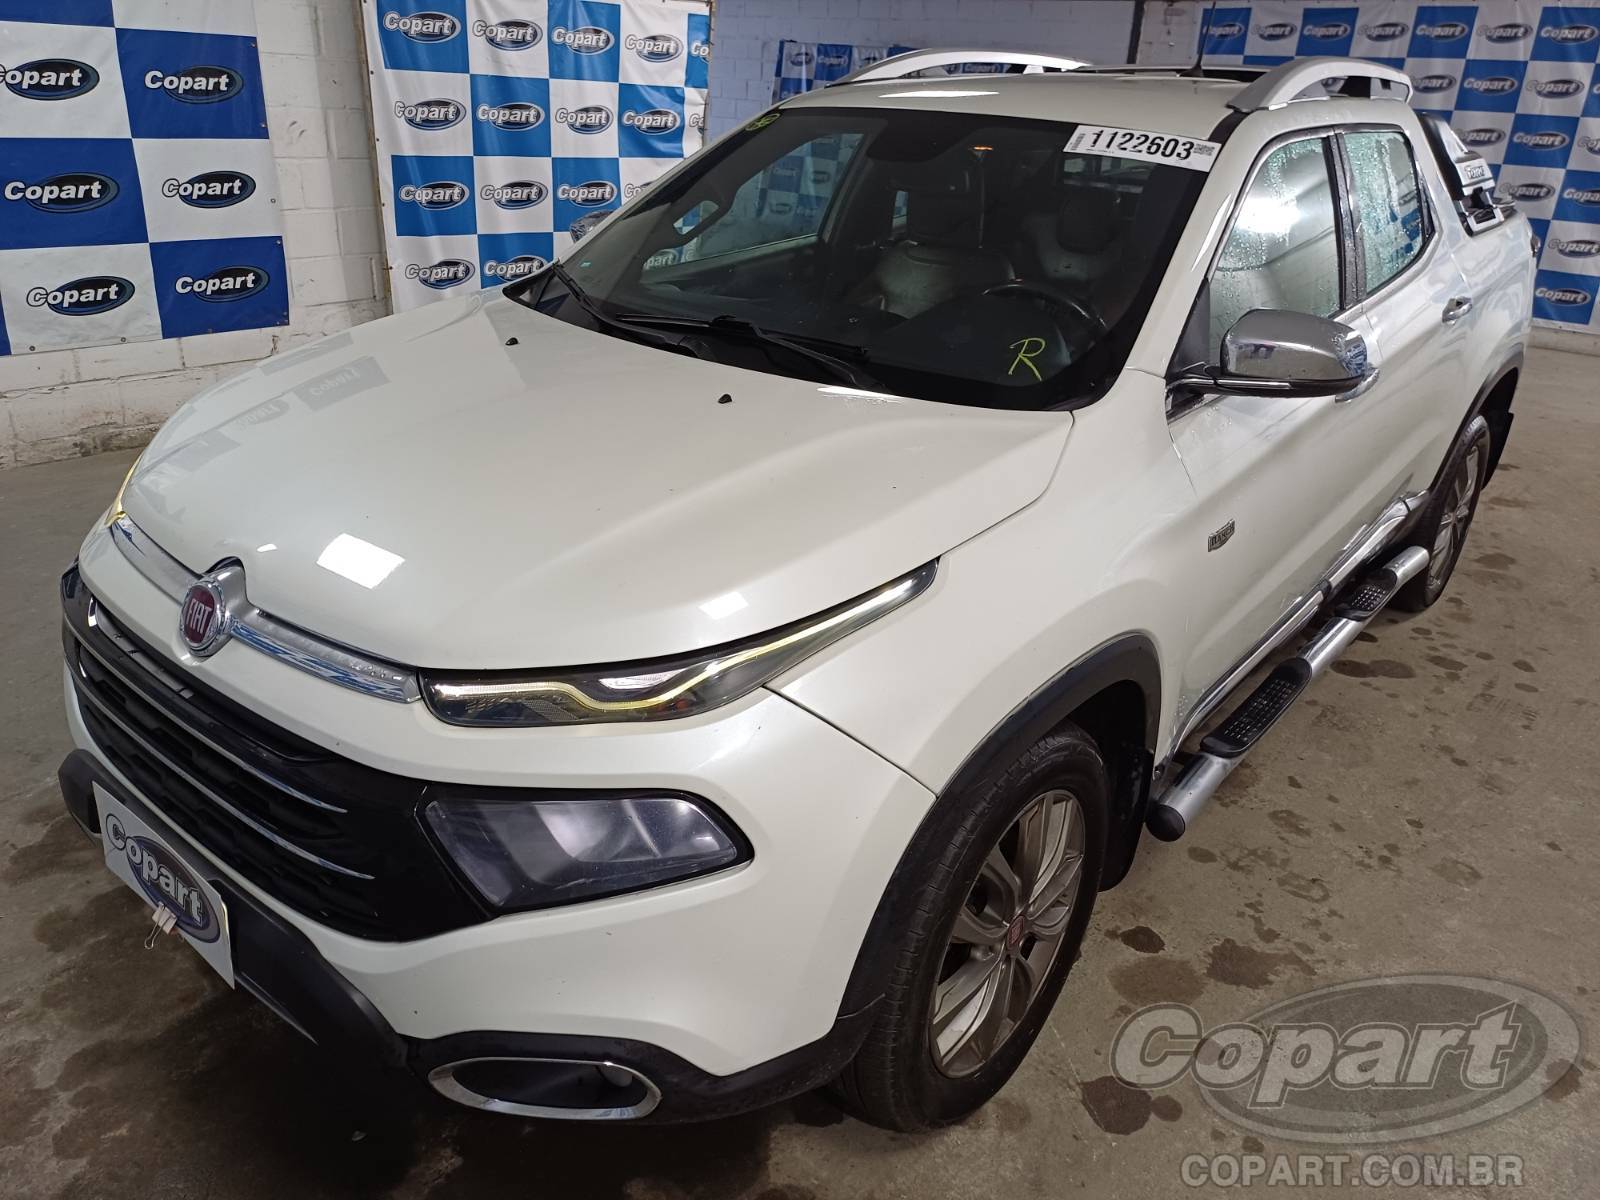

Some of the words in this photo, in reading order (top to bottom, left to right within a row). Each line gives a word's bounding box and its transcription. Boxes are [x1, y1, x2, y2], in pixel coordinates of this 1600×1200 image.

[384, 11, 453, 35] Copart
[472, 20, 534, 44] Copart
[1252, 25, 1291, 37] Copart
[1303, 24, 1345, 37] Copart
[1359, 24, 1402, 38] Copart
[1416, 25, 1462, 38] Copart
[1477, 25, 1525, 39] Copart
[1540, 26, 1591, 40] Copart
[553, 28, 607, 49] Copart
[625, 34, 675, 54] Copart
[145, 70, 230, 94] Copart
[1464, 77, 1512, 91] Copart
[1526, 80, 1577, 94] Copart
[394, 101, 456, 122] Copart
[476, 104, 538, 126] Copart
[554, 108, 609, 129] Copart
[621, 108, 675, 129] Copart
[1091, 130, 1195, 161] 1122603
[1513, 132, 1563, 146] Copart
[4, 179, 103, 203] Copart
[162, 177, 242, 199] Copart
[400, 185, 461, 206] Copart
[480, 185, 539, 206] Copart
[557, 183, 612, 204] Copart
[1499, 183, 1548, 198] Copart
[1548, 239, 1600, 255] Copart
[405, 261, 465, 283] Copart
[484, 259, 541, 279] Copart
[175, 271, 256, 294] Copart
[26, 282, 120, 307] Copart
[1536, 287, 1585, 303] Copart
[1008, 337, 1046, 381] R
[186, 598, 213, 634] FIAT
[105, 813, 204, 926] Copart
